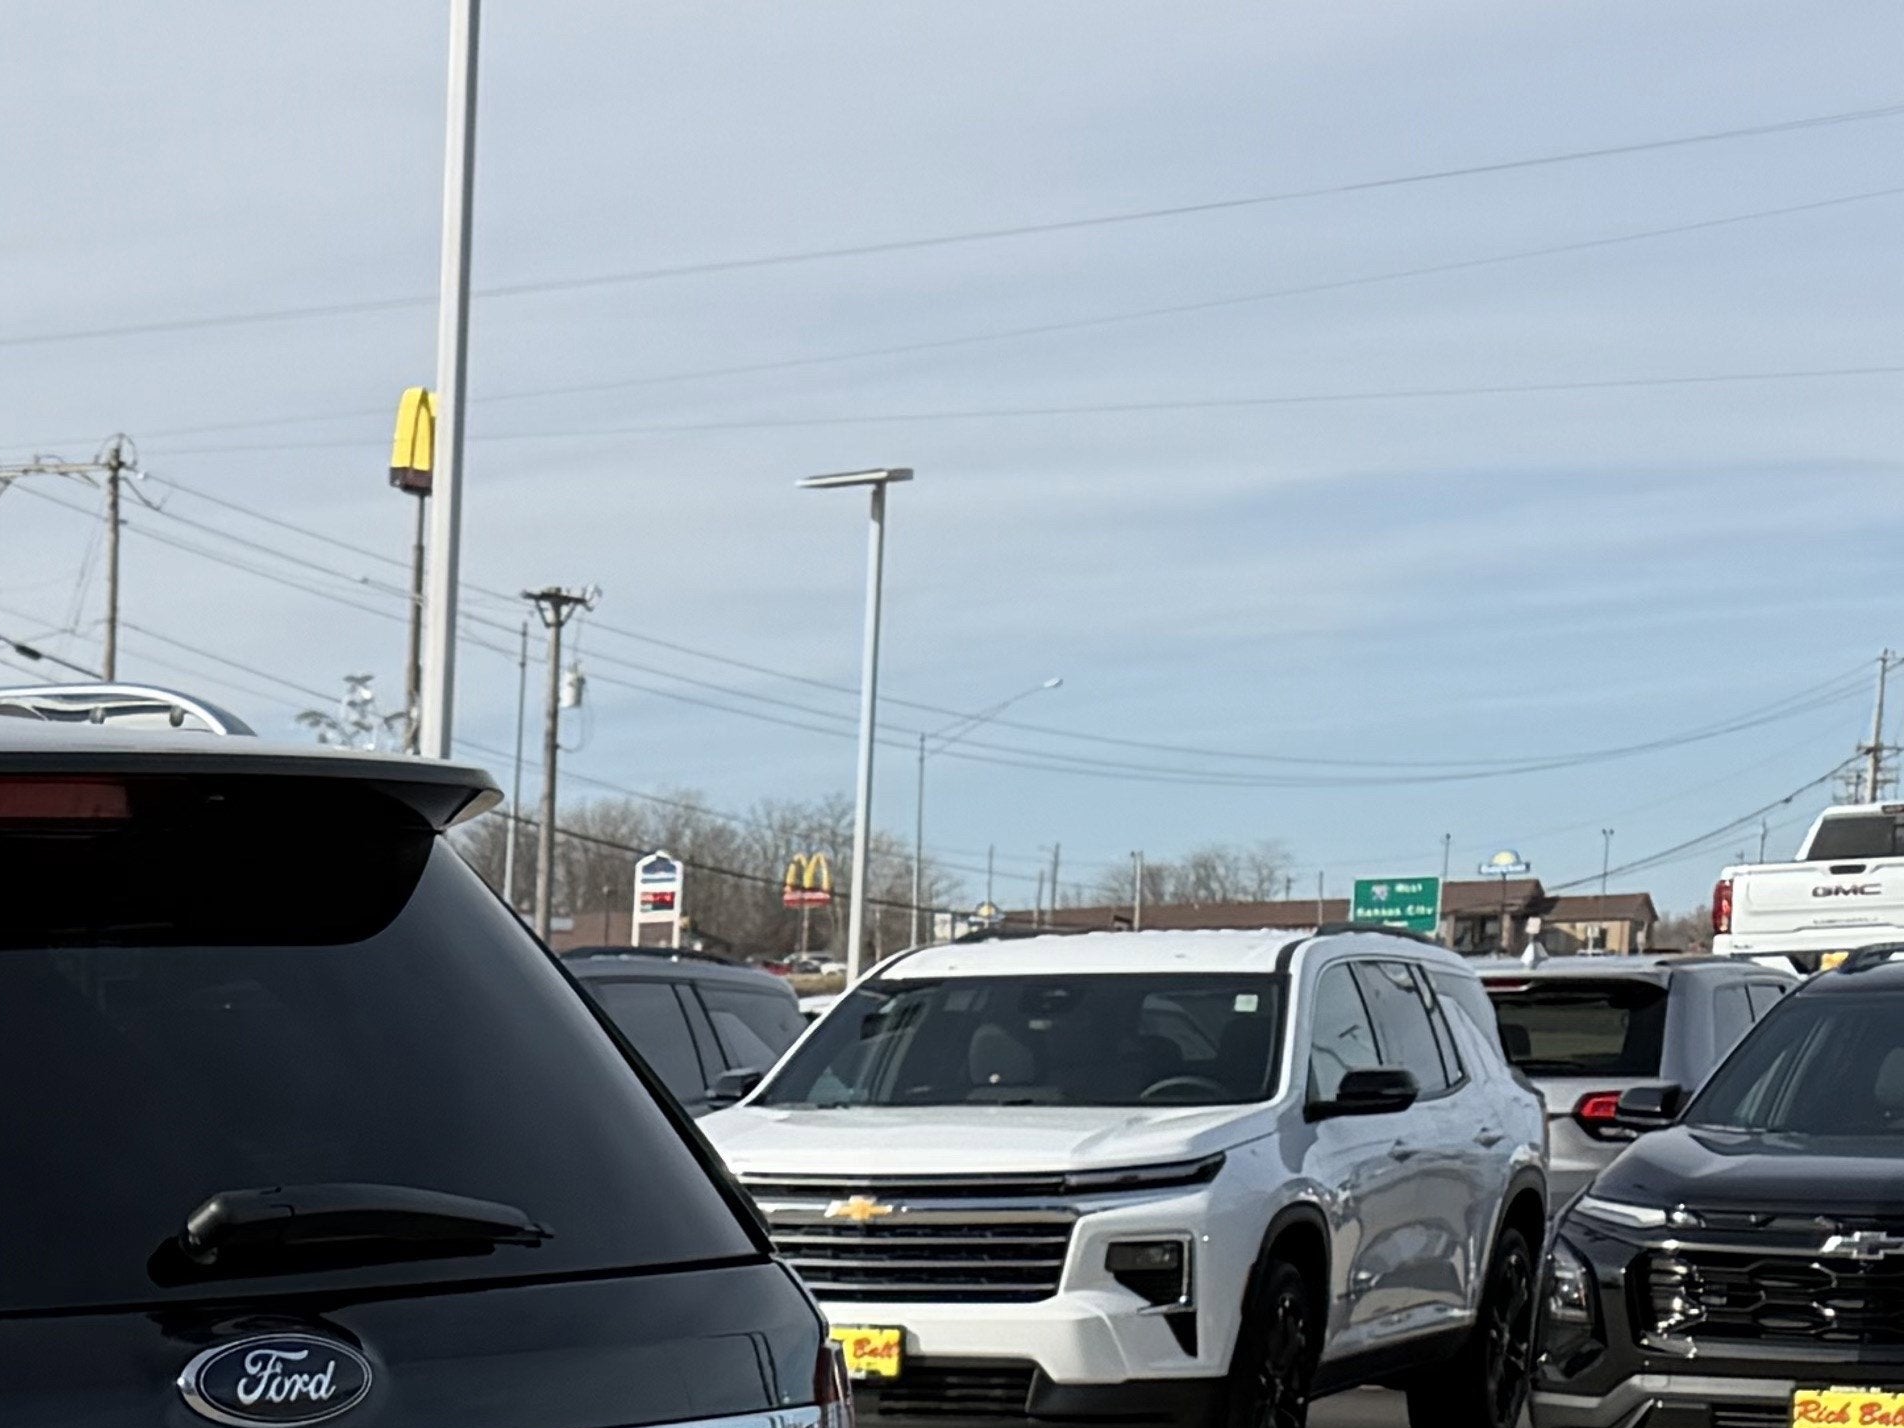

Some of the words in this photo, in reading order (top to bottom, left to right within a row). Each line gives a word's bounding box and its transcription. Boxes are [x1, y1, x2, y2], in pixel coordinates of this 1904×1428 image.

[1811, 883, 1882, 897] GMC
[236, 1349, 337, 1405] Ford
[1796, 1399, 1852, 1424] Rick
